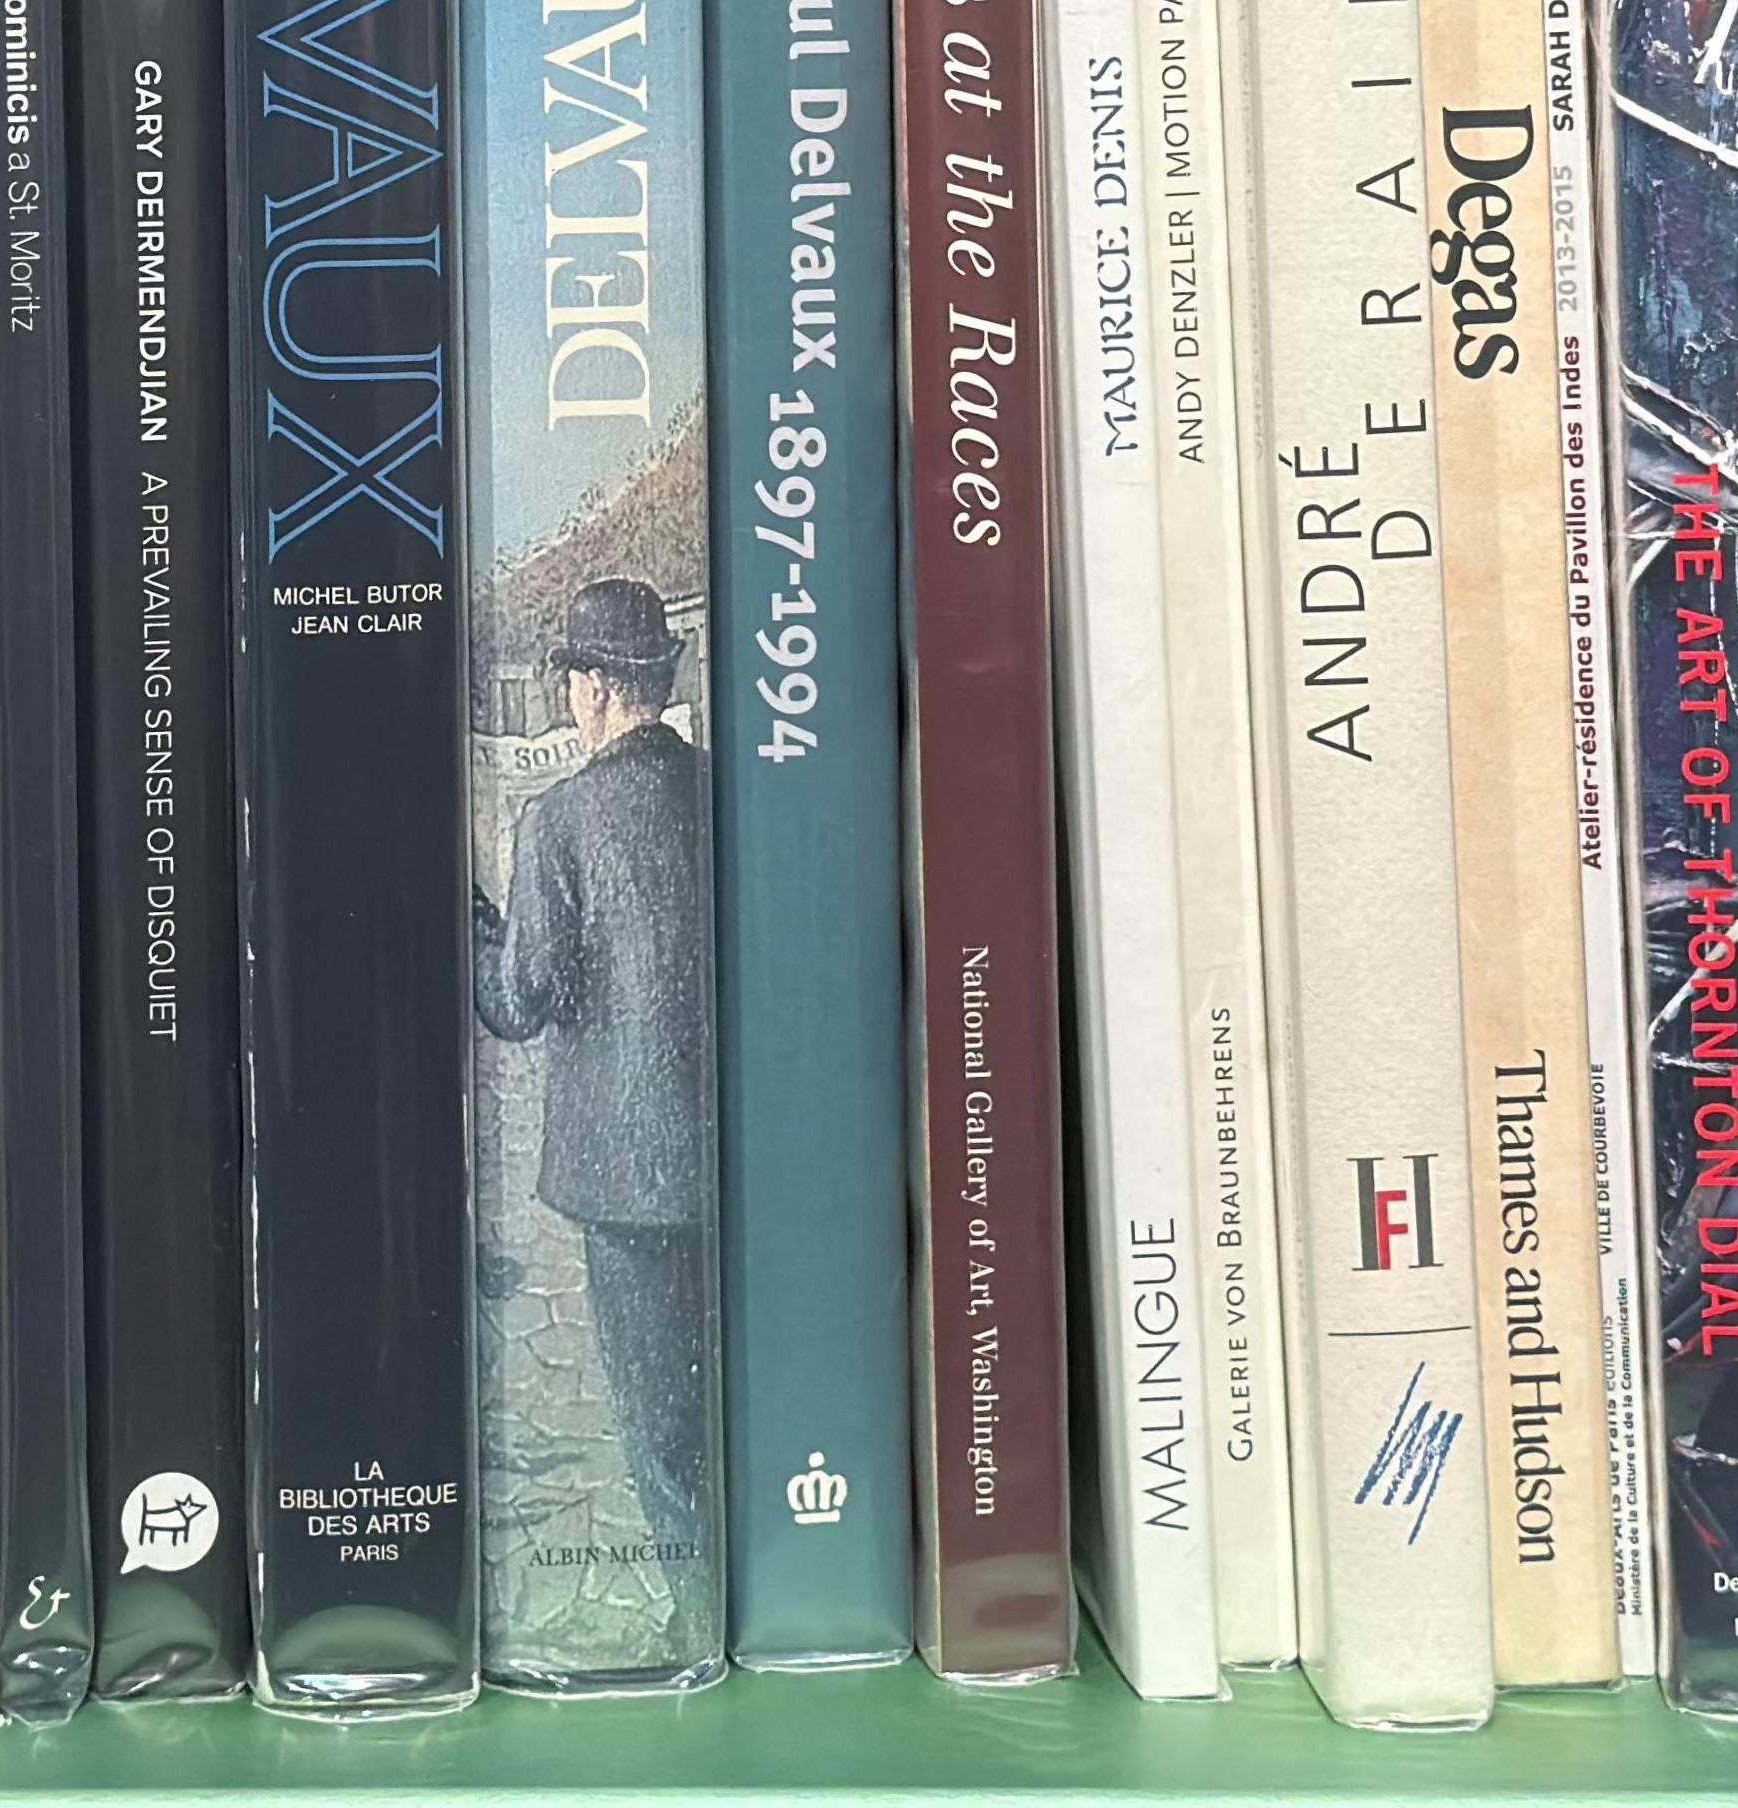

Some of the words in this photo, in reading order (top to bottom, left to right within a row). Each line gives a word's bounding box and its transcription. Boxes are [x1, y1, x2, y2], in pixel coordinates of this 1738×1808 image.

[133, 58, 164, 155] GARY
[943, 32, 998, 114] at
[1160, 40, 1192, 177] MOTION
[1548, 31, 1575, 133] SARAH
[7, 148, 29, 169] a
[1088, 55, 1128, 208] DENIS
[7, 177, 39, 219] St.
[790, 87, 851, 371] Delvaux
[943, 153, 1013, 277] the
[1429, 103, 1535, 380] Degas
[1553, 166, 1579, 314] 2013-2015
[9, 227, 42, 329] Moritz
[135, 168, 169, 440] DEIRMENDJIAN
[1168, 210, 1199, 358] DENZLER
[1095, 228, 1139, 457] MAURICE
[1560, 335, 1582, 410] Indes
[949, 304, 1016, 547] Races
[1175, 371, 1205, 465] ANDY
[1562, 422, 1585, 469] des
[140, 468, 169, 495] A
[1566, 479, 1591, 586] Pavillon
[1672, 461, 1723, 581] THE
[141, 500, 171, 696] PREVAILING
[273, 586, 360, 605] MICHEL
[366, 583, 442, 604] BUTOR
[291, 616, 348, 634] JEAN
[357, 613, 423, 633] CLAIR
[754, 389, 828, 762] 1897-1994
[1278, 441, 1373, 763] ANDRÉ
[1569, 595, 1593, 626] du
[1676, 607, 1728, 723] ART
[143, 706, 173, 816] SENSE
[1573, 636, 1603, 871] Atelier-résidence
[1682, 746, 1732, 825] OF
[144, 825, 175, 873] OF
[142, 882, 178, 1039] DISQUIET
[960, 945, 992, 1079] National
[960, 1091, 994, 1207] Gallery
[1211, 1008, 1243, 1247] BRAUNBEHRENS
[1493, 1049, 1550, 1253] Thames
[964, 1261, 996, 1316] Art,
[968, 1218, 997, 1253] of
[1223, 1262, 1248, 1325] VON
[1504, 1267, 1560, 1356] and
[969, 1327, 1000, 1516] Washington
[1130, 1219, 1190, 1532] MALINGUE
[1226, 1337, 1254, 1463] GALERIE
[279, 1483, 458, 1509] BIBLIOTHEQUE
[354, 1461, 384, 1481] LA
[1509, 1370, 1567, 1564] Hudson
[308, 1515, 357, 1536] DES
[365, 1512, 431, 1534] ARTS
[340, 1544, 399, 1562] PARIS
